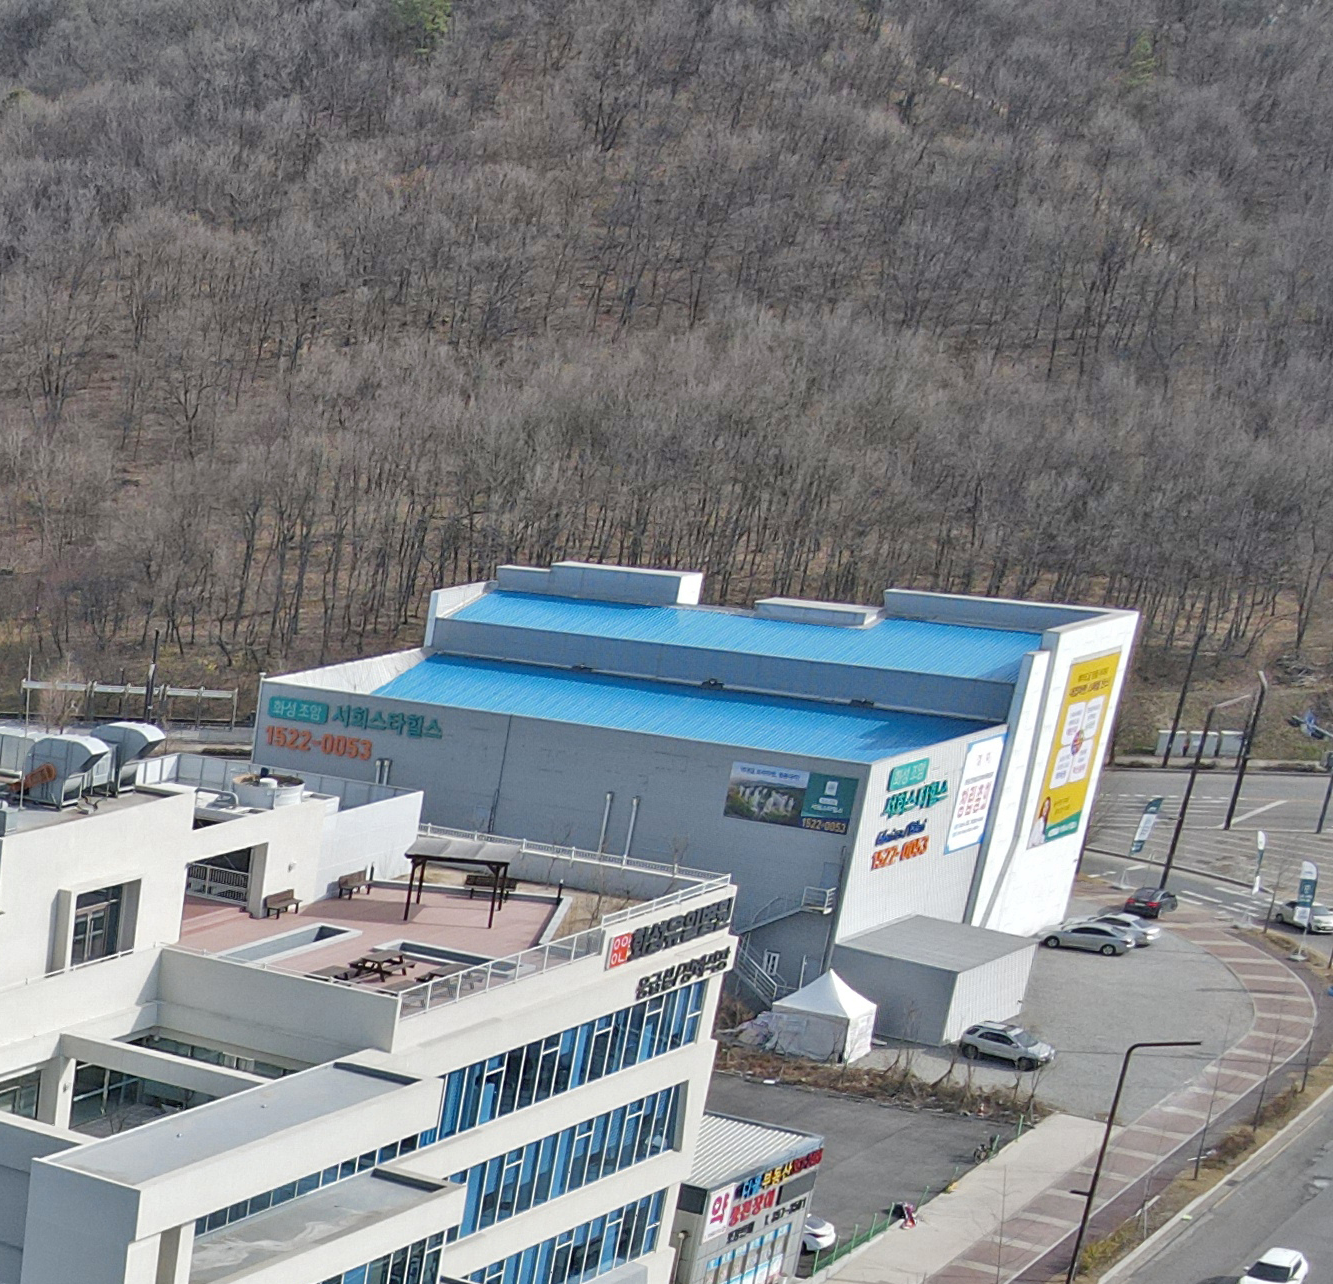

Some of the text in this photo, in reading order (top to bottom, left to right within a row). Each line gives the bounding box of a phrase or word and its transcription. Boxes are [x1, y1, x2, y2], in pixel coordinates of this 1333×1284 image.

[272, 701, 443, 739] 화성 조암 서희스타힐스
[265, 725, 373, 761] 1522-0053
[710, 1193, 729, 1224] 약
